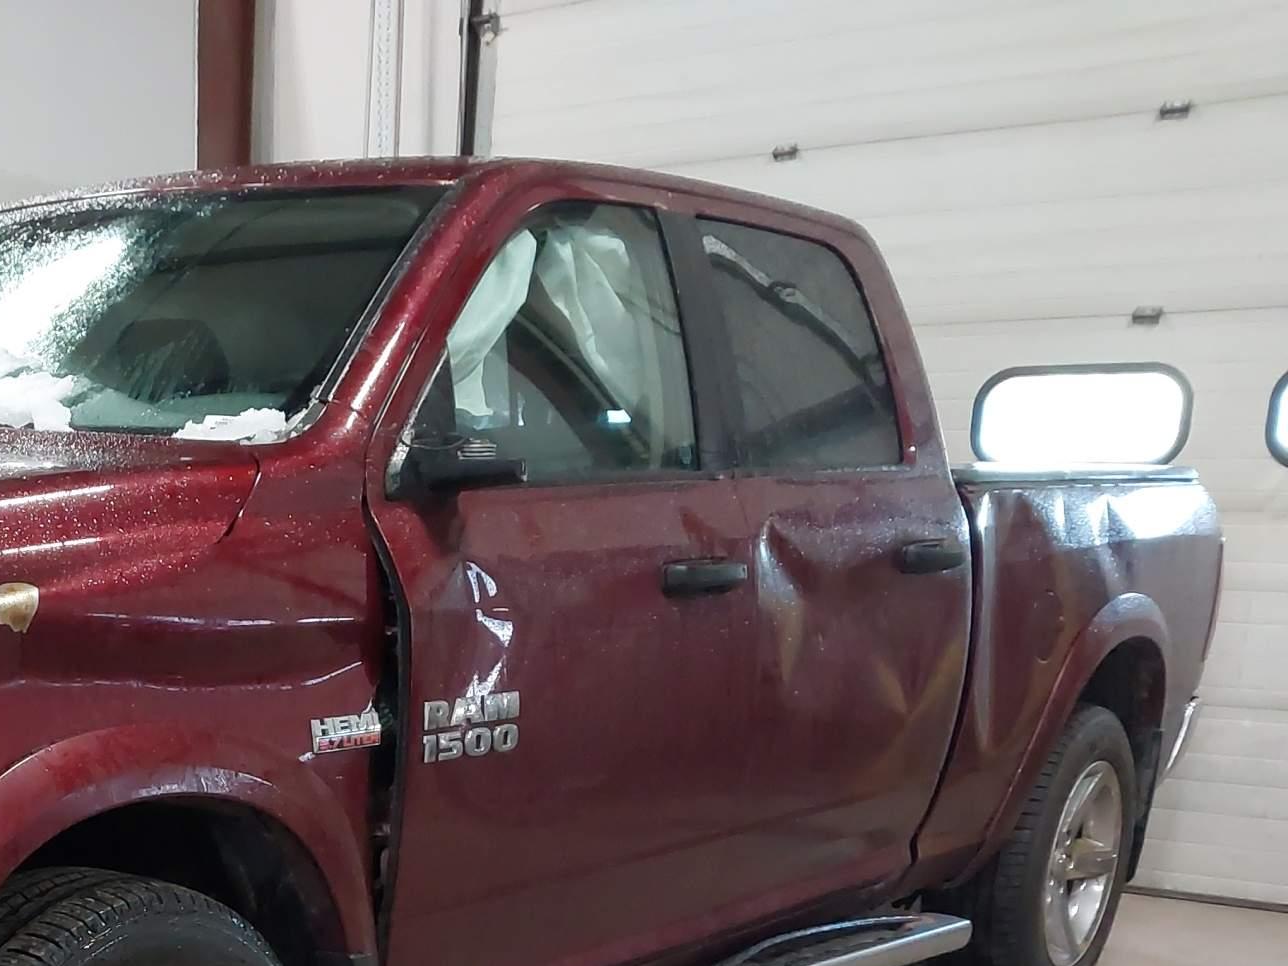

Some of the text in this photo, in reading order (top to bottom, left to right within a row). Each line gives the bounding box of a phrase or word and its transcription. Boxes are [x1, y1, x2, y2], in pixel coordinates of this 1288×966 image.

[311, 712, 381, 736] HEMI
[424, 690, 521, 731] RAM
[423, 723, 520, 763] 1500
